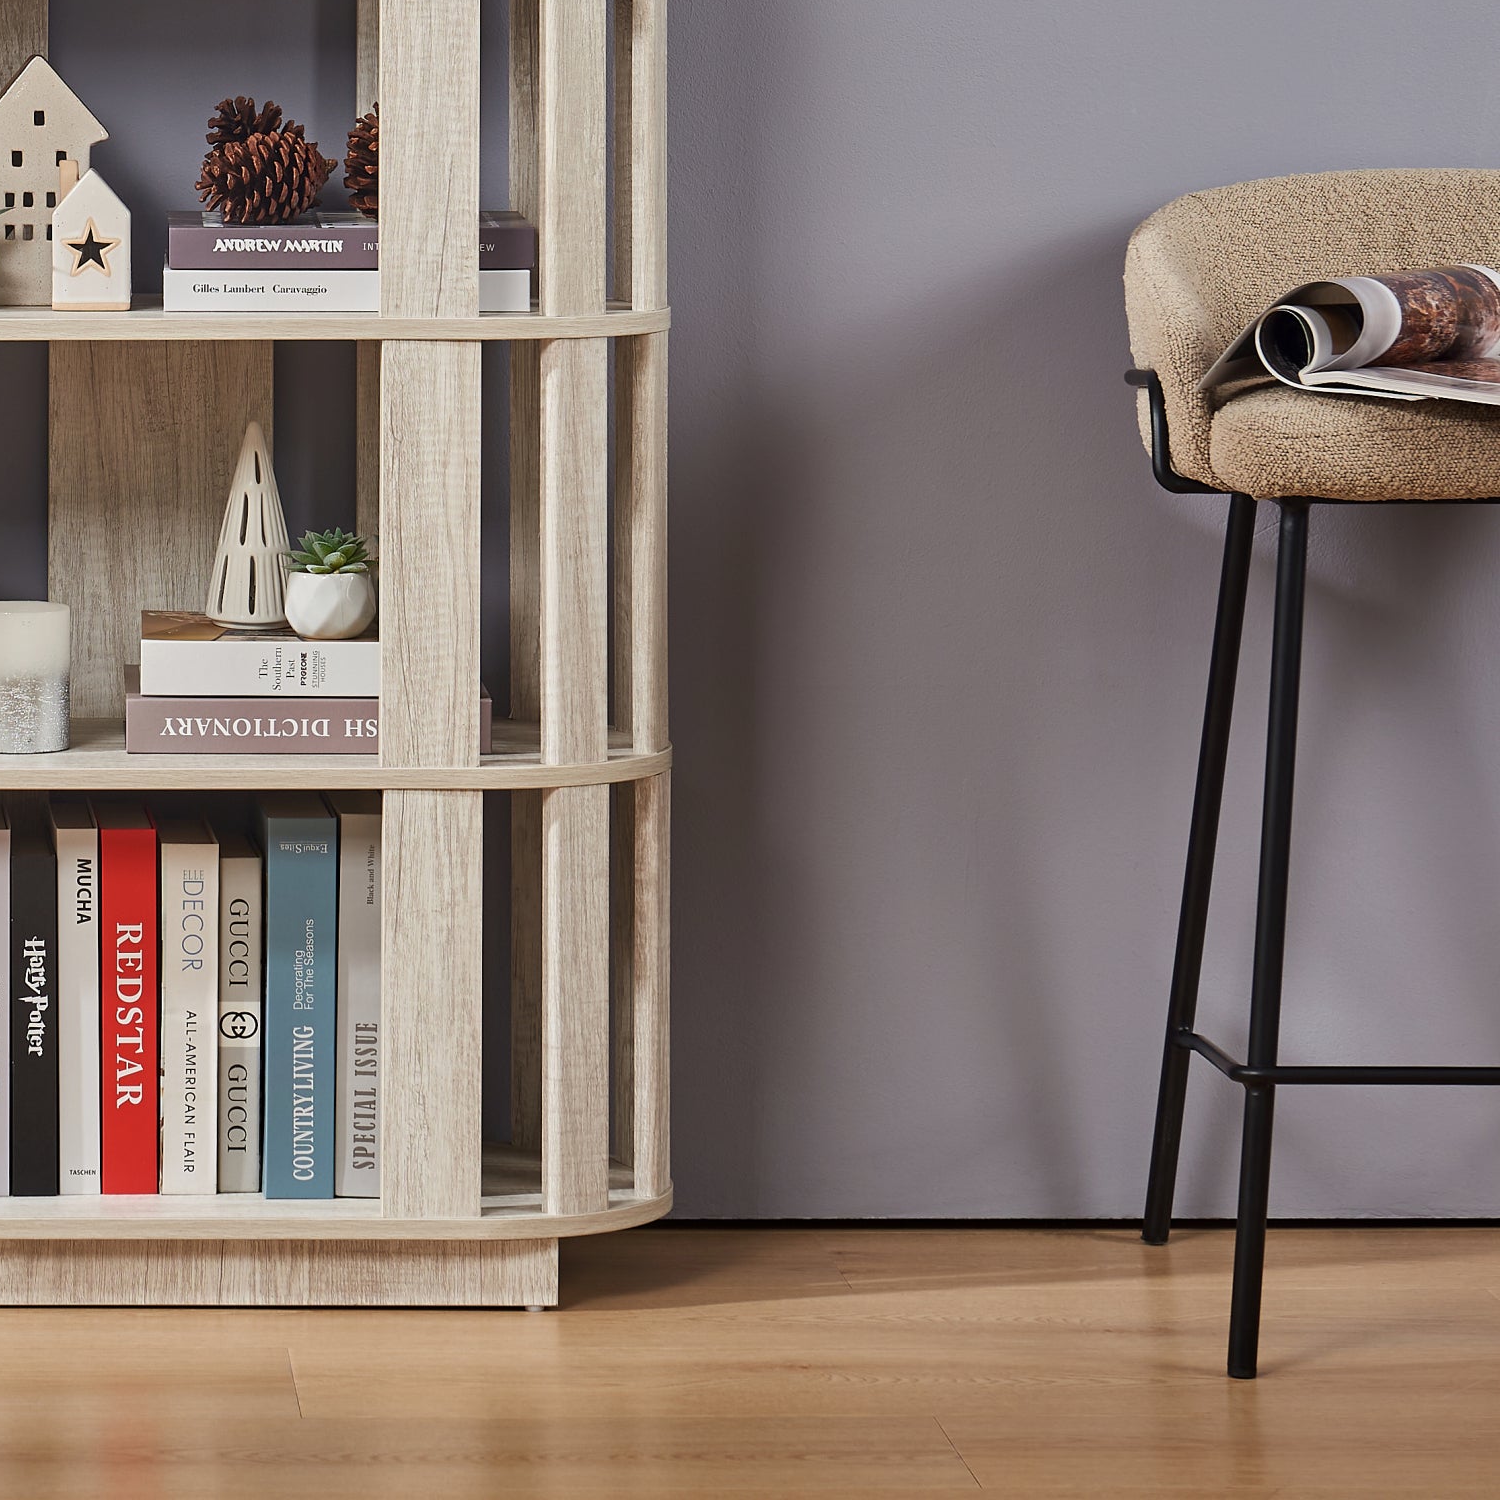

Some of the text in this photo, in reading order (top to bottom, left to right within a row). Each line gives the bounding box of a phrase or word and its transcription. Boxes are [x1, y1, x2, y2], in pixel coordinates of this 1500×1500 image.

[213, 238, 343, 253] ANDREW MARTIN
[192, 284, 328, 296] Gilles Lambert Caravaggio
[258, 659, 268, 679] The
[271, 647, 282, 691] Southern
[286, 659, 295, 678] Past
[160, 717, 330, 737] DICTIONARY
[76, 858, 92, 925] MUCHA
[183, 869, 204, 880] ELLE
[367, 869, 375, 883] and
[182, 880, 204, 972] DECOR
[228, 898, 250, 988] GUCCI
[293, 950, 305, 1010] Decorating
[304, 919, 314, 1010] For The Seasons
[116, 922, 143, 1109] REDSTAR
[183, 1010, 197, 1173] ALL-AMERICAN FLAIR
[227, 1064, 248, 1153] GUCCI
[293, 1025, 314, 1181] COUNTRY LIVING
[352, 1023, 378, 1170] SPECIAL ISSUE
